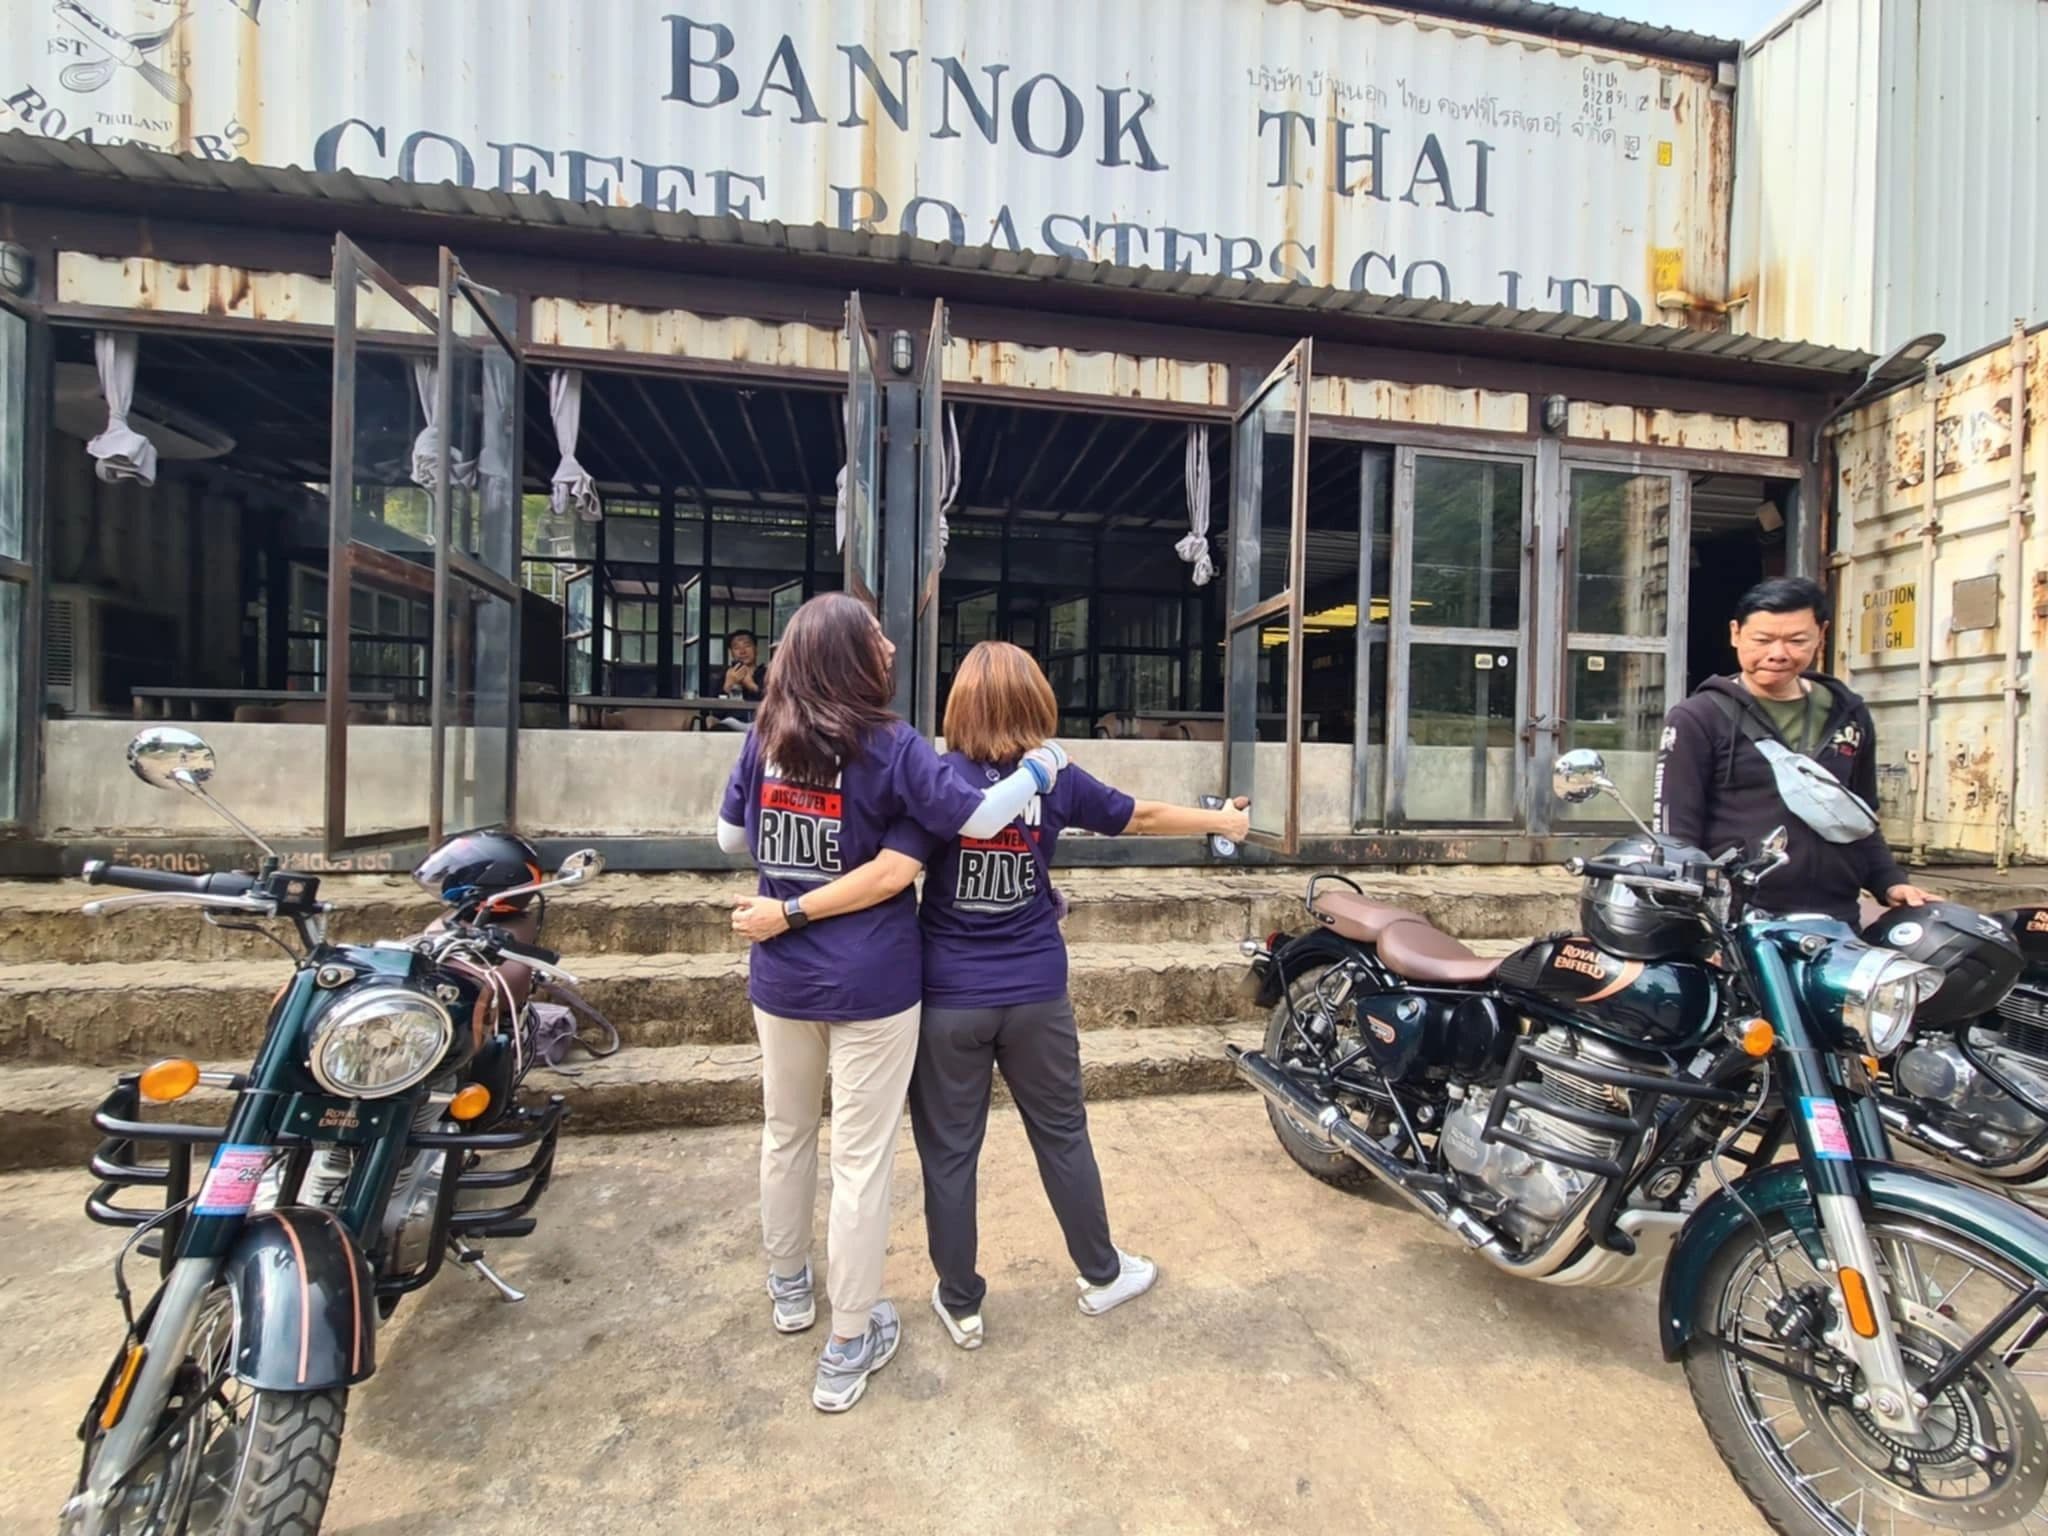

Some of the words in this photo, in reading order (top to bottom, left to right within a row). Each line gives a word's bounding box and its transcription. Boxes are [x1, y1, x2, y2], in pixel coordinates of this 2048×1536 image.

[661, 14, 1169, 171] BANNOK
[1258, 109, 1495, 217] THAI
[1862, 585, 1915, 611] CAUTION
[770, 789, 827, 814] DISCOVER
[757, 808, 842, 872] RIDE
[955, 849, 1036, 903] RIDE
[1562, 944, 1600, 963] ROYAL
[1553, 955, 1606, 980] ENFIELD
